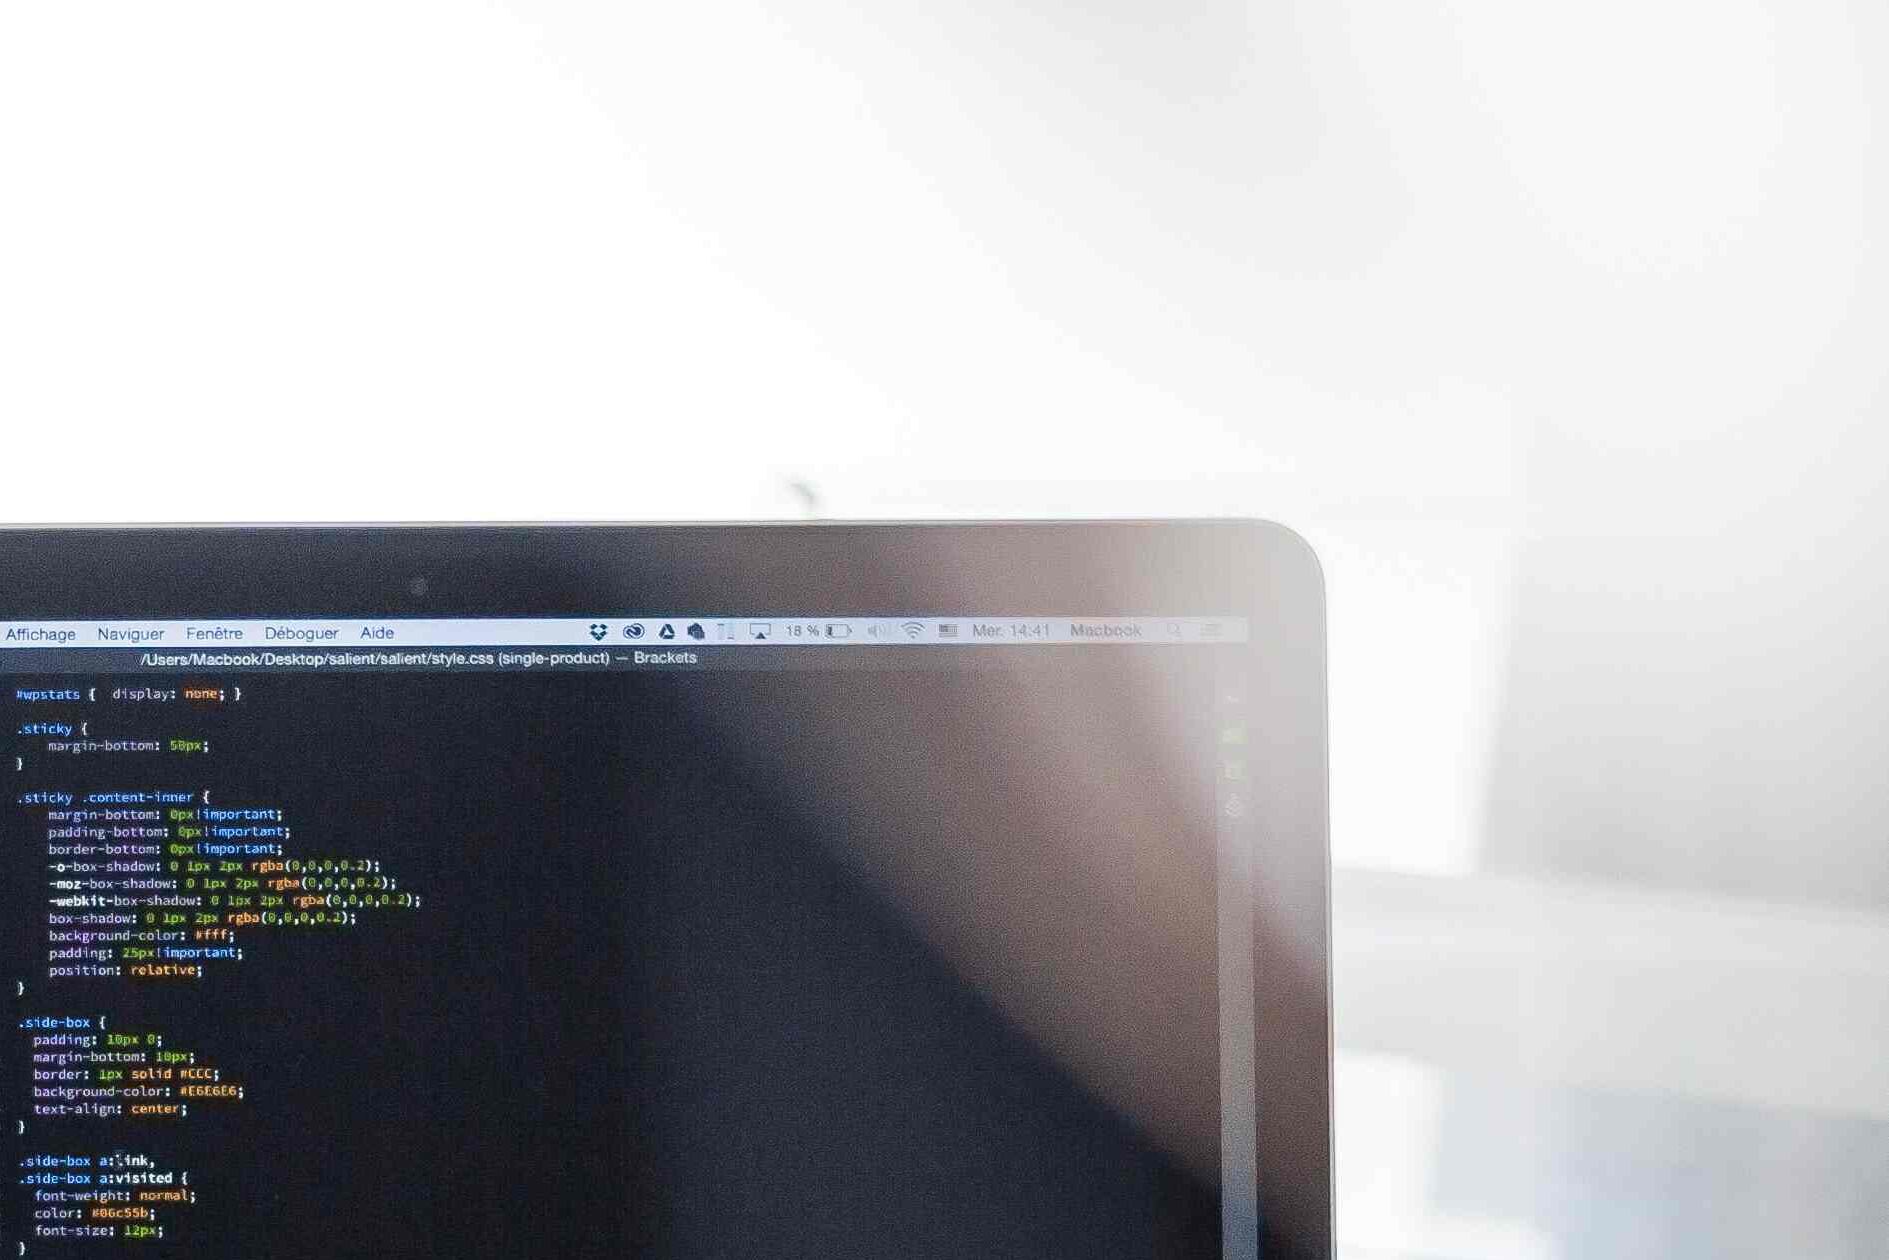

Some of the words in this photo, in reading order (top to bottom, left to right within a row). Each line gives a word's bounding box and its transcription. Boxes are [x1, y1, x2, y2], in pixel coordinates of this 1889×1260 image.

[6, 628, 76, 643] Affichage
[98, 628, 165, 643] Naviguer
[187, 627, 243, 639] Fenêtre
[265, 626, 339, 642] Déboguer
[361, 627, 394, 639] Aide
[1011, 623, 1049, 637] 14:41
[1071, 624, 1141, 637] Macbook
[498, 652, 609, 667] (single-product)
[635, 651, 697, 664] Brackets
[113, 688, 175, 702] display:
[185, 689, 225, 701] none;
[18, 723, 72, 736] .sticky
[48, 740, 160, 754] margin-bottom:
[18, 791, 73, 806] .sticky
[84, 791, 193, 803] .content-inner
[49, 809, 159, 823] margin-bottom:
[48, 826, 168, 840] padding-bottom:
[48, 843, 160, 855] border-bottom:
[49, 913, 136, 924] box-shadow:
[49, 929, 185, 944] background-color:
[49, 947, 112, 961] padding:
[49, 965, 120, 978] position:
[131, 964, 202, 978] relative;
[19, 1016, 90, 1029] .side-box
[33, 1034, 97, 1047] padding:
[33, 1051, 145, 1065] margin-bottom:
[34, 1069, 88, 1080] border:
[132, 1068, 172, 1080] solid
[34, 1085, 170, 1100] background-color:
[34, 1102, 121, 1117] text-align:
[131, 1104, 187, 1117] center;
[20, 1155, 90, 1168] .side-box
[20, 1173, 90, 1184] .side-box
[99, 1172, 173, 1185] a:visited
[35, 1189, 130, 1204] font-weight:
[140, 1188, 196, 1203] normal;
[35, 1207, 81, 1219] color:
[36, 1225, 114, 1237] font-size:
